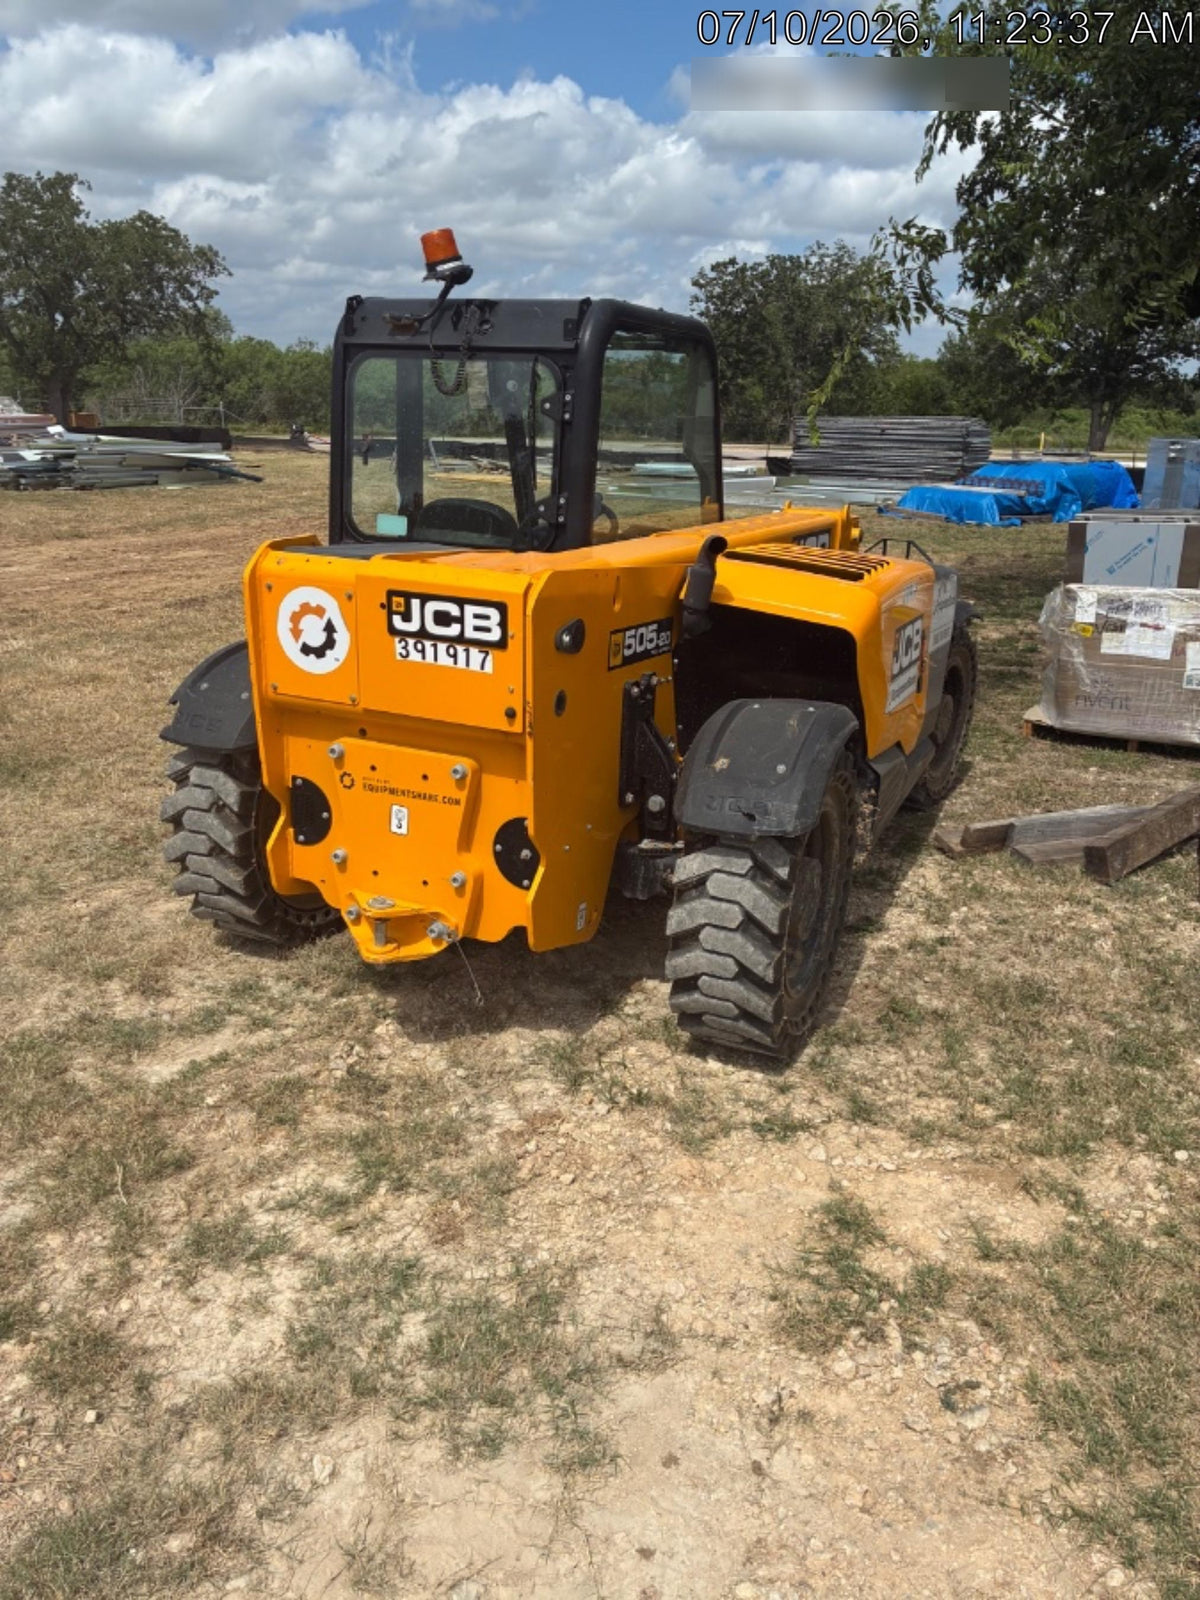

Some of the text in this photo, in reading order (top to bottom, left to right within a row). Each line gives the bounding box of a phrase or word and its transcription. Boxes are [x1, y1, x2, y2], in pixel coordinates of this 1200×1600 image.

[392, 597, 502, 642] JCB
[397, 637, 491, 671] 391917
[891, 617, 923, 676] JCB
[362, 782, 462, 807] EQUIPMENTSHARE.COM
